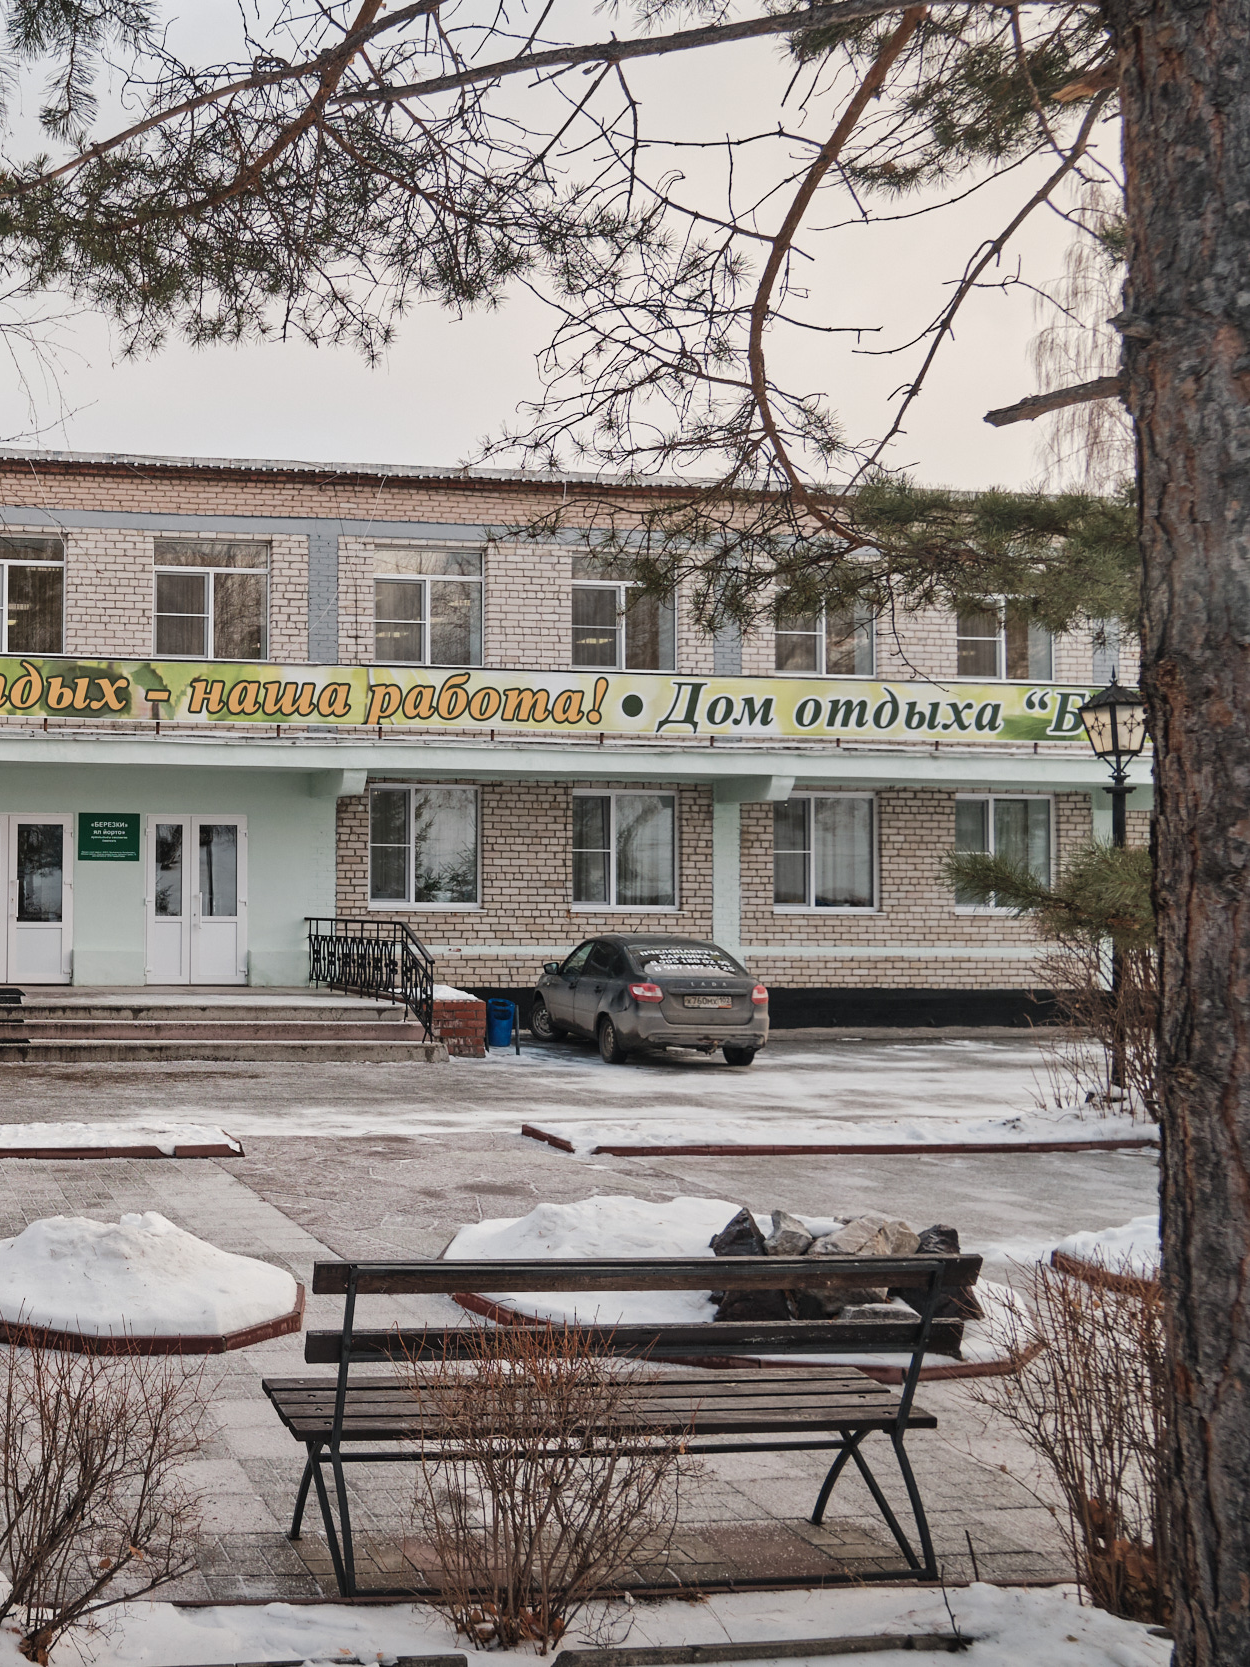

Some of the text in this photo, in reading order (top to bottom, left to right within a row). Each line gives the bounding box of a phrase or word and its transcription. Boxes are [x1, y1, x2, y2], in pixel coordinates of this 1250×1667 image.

[188, 676, 351, 718] наша
[366, 672, 609, 725] работа!
[655, 681, 774, 734] Дом
[794, 687, 1003, 733] отдыха
